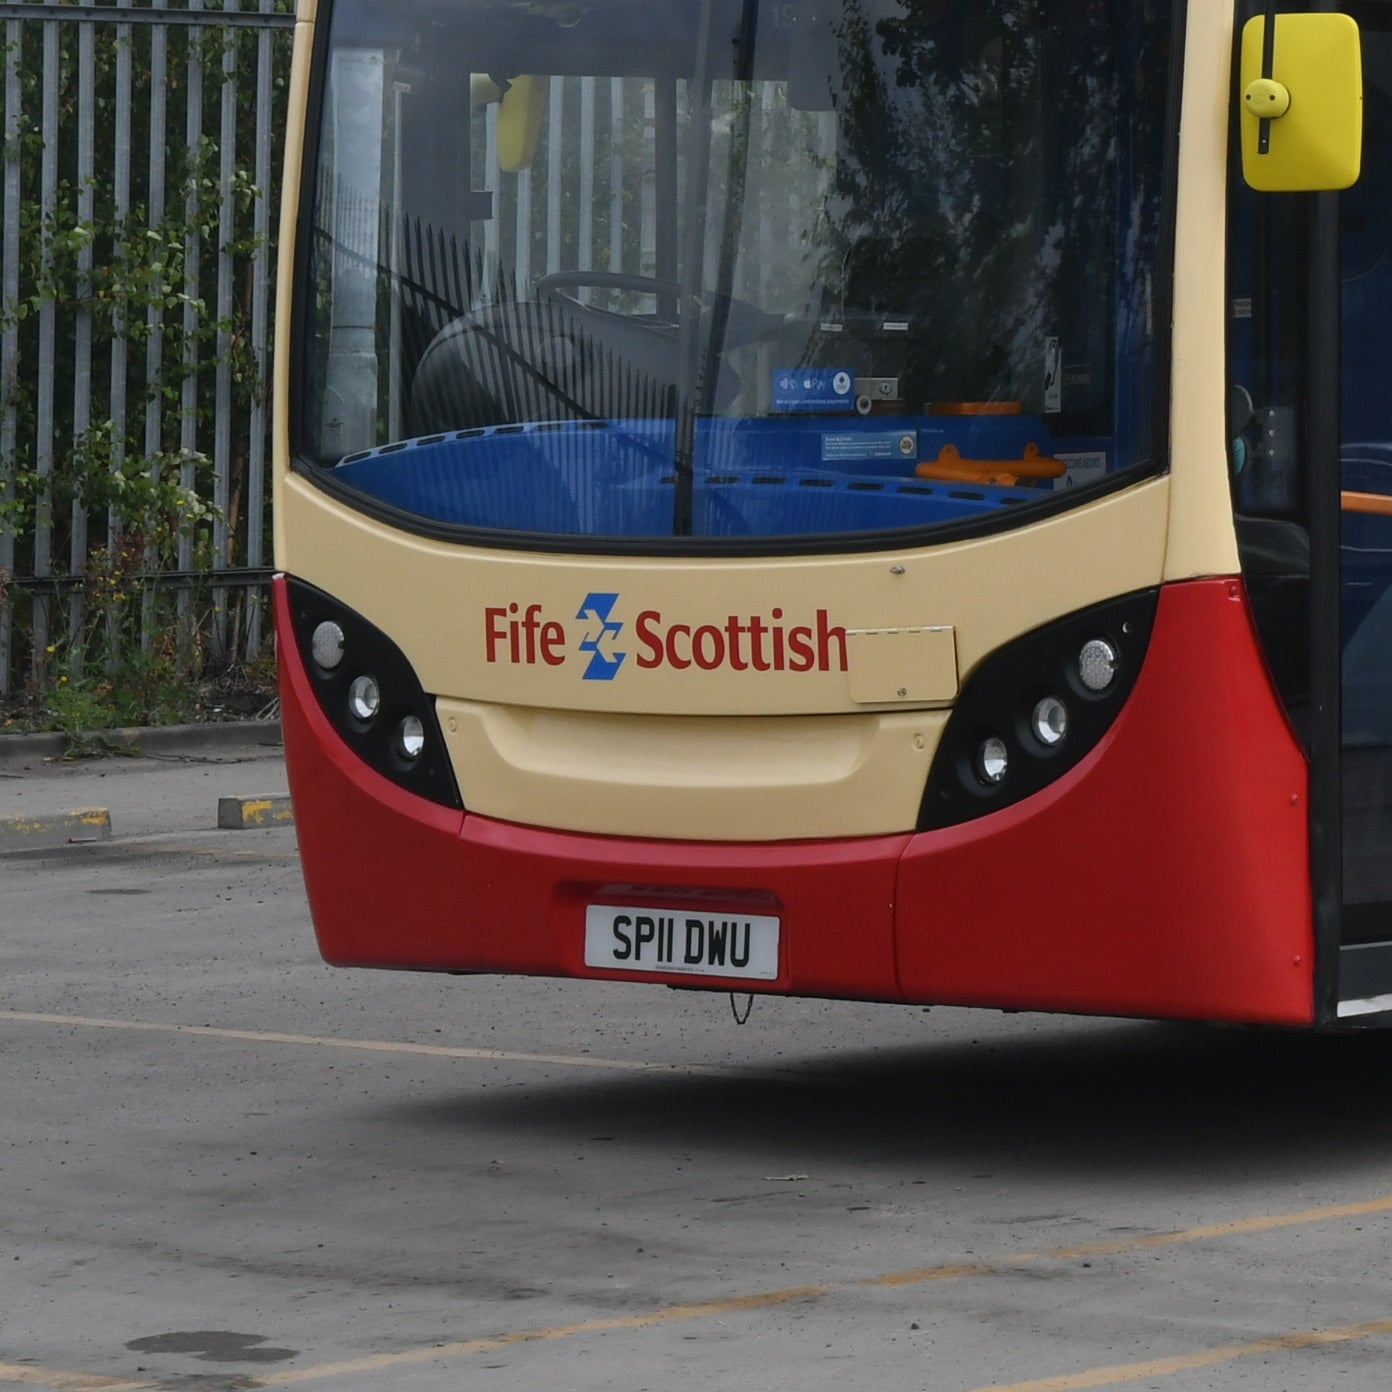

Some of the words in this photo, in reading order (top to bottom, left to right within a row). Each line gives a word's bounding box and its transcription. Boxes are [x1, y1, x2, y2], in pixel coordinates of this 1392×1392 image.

[484, 602, 566, 666] Fife
[635, 608, 848, 672] Scottish
[612, 915, 674, 963] SP11
[684, 919, 751, 968] DWU
